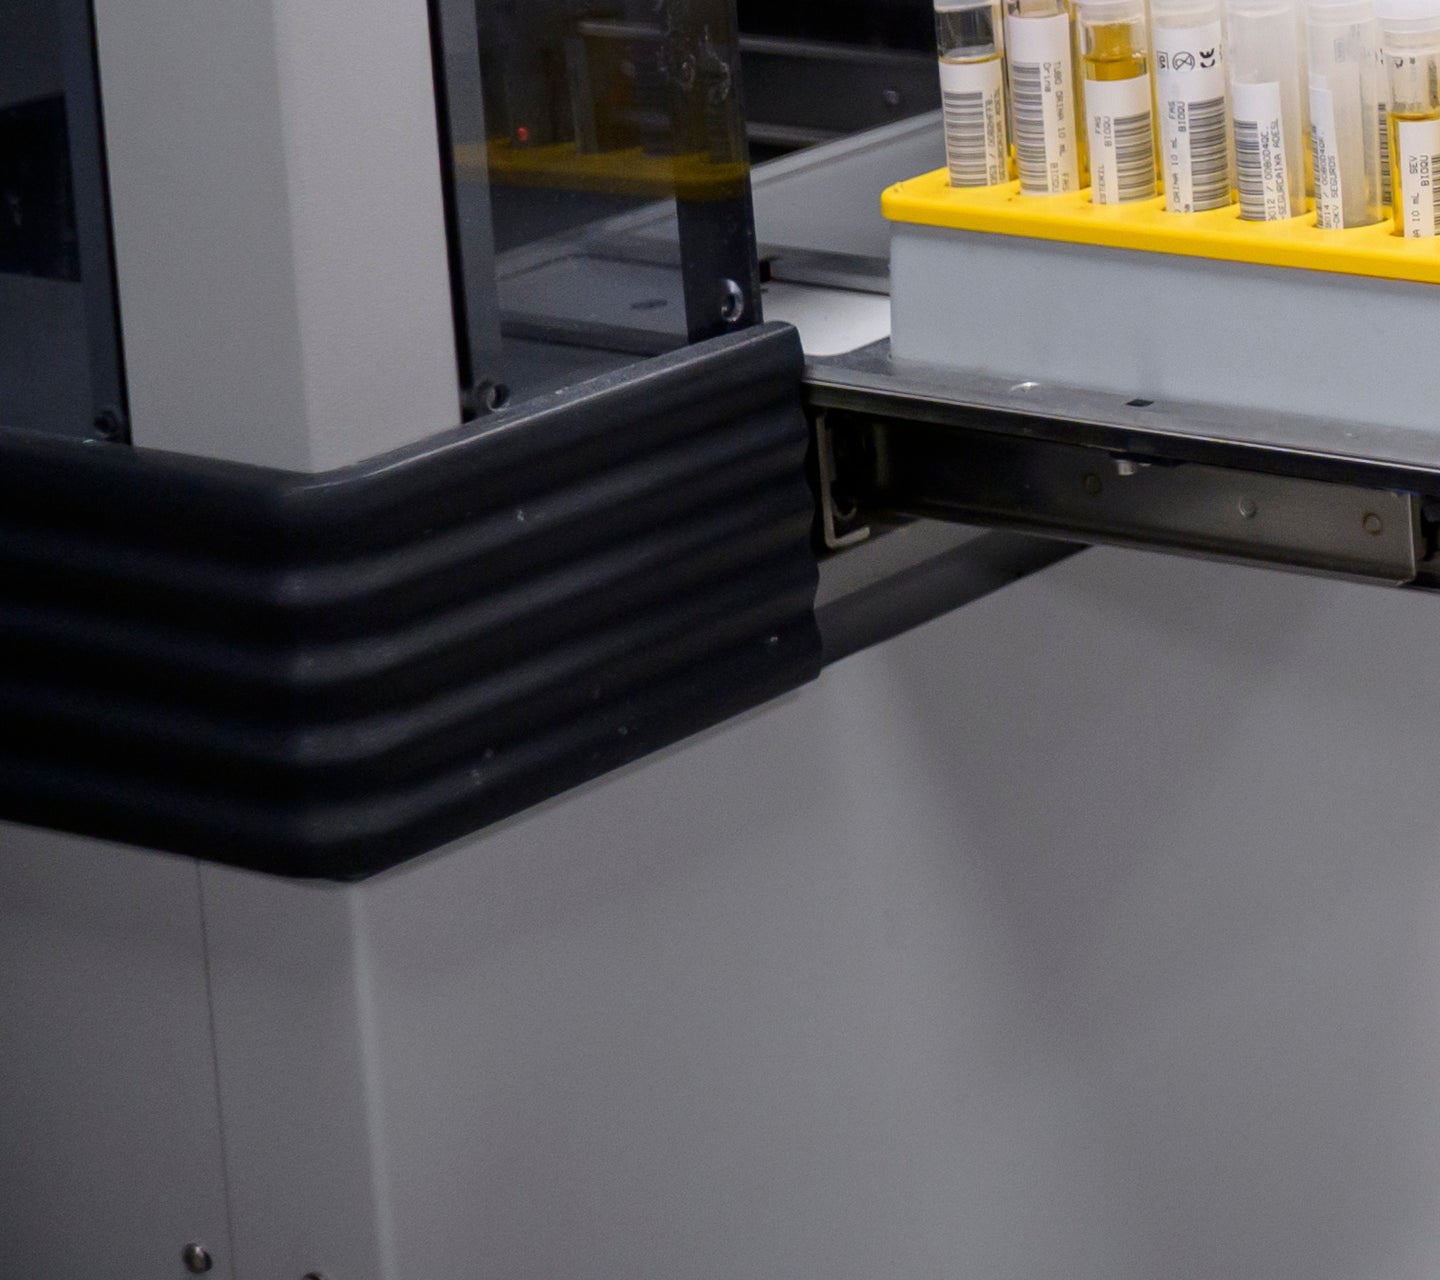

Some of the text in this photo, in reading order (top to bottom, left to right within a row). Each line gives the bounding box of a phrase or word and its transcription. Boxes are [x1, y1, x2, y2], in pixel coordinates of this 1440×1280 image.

[1043, 62, 1052, 93] Orina
[1168, 101, 1176, 120] FAS
[1177, 101, 1187, 132] BIOQU
[1057, 127, 1066, 139] 10
[1104, 116, 1112, 147] BIOQU
[1170, 154, 1179, 166] 10
[1409, 155, 1418, 174] SEV
[1328, 155, 1338, 198] SEGUROS
[1420, 155, 1429, 186] BIOQU
[1411, 193, 1419, 204] mL
[1412, 210, 1420, 222] 10
